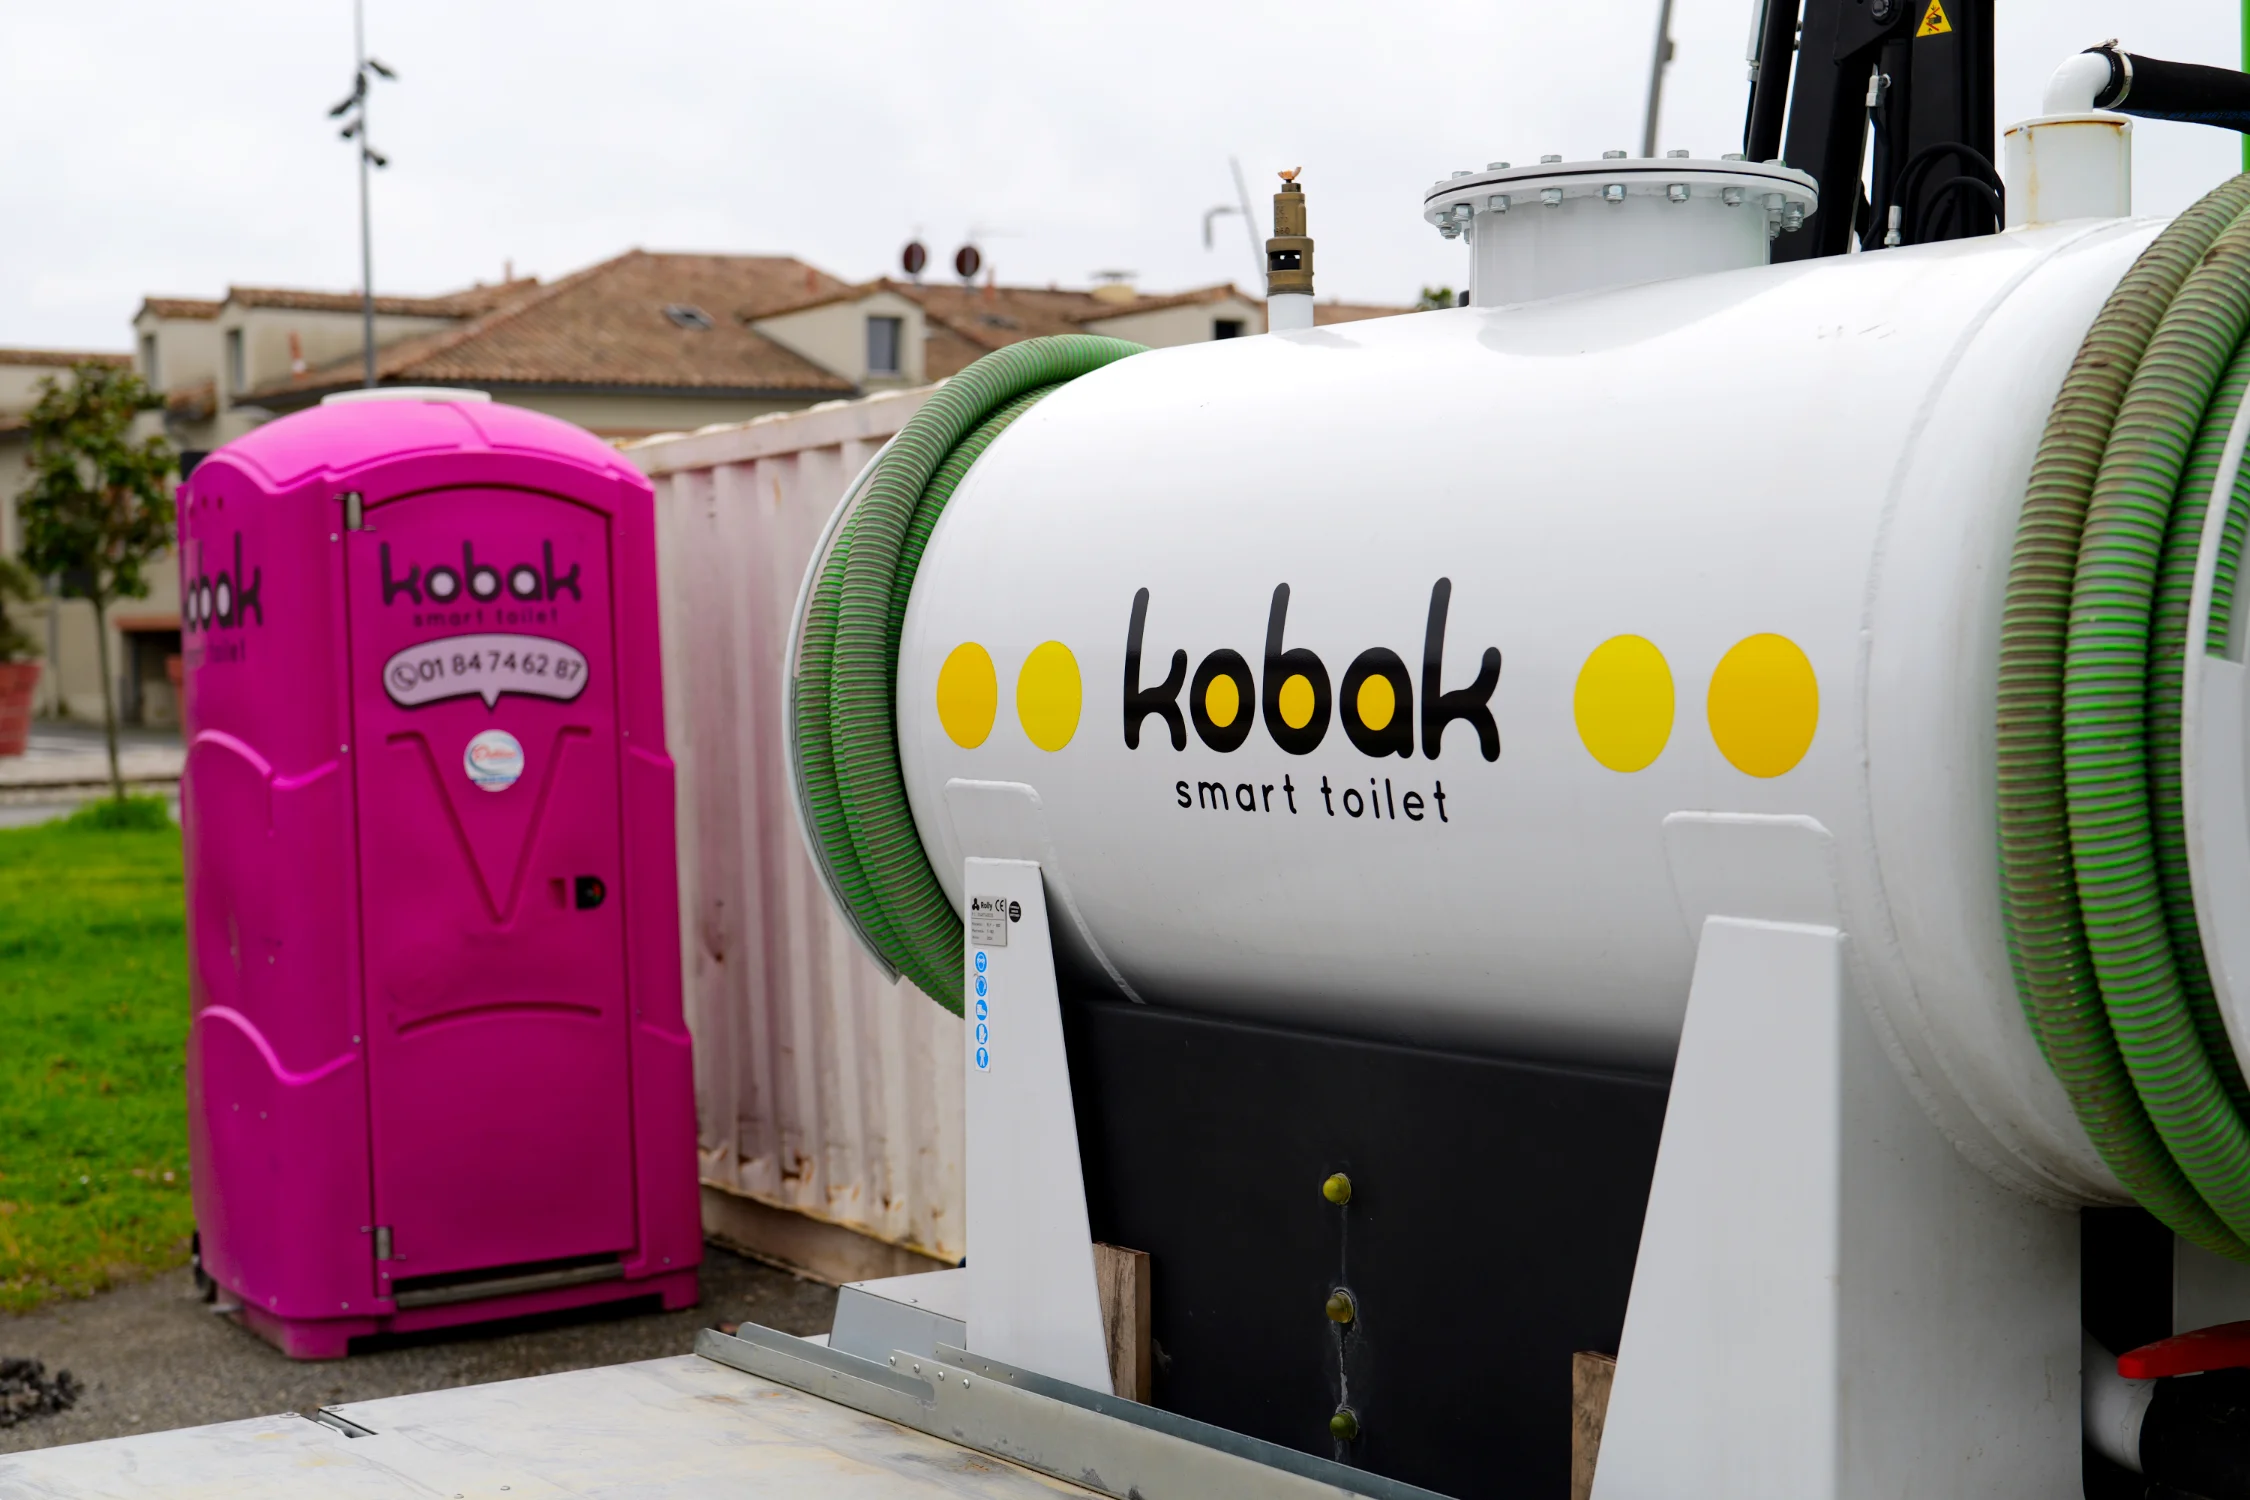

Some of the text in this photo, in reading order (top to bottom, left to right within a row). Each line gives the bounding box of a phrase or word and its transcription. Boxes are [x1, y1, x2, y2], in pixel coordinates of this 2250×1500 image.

[379, 540, 582, 606] kobak
[413, 607, 558, 627] smart toilet
[419, 650, 583, 681] 01 84 74 62 87
[1124, 577, 1502, 762] kobak
[1175, 774, 1449, 823] smart toilet
